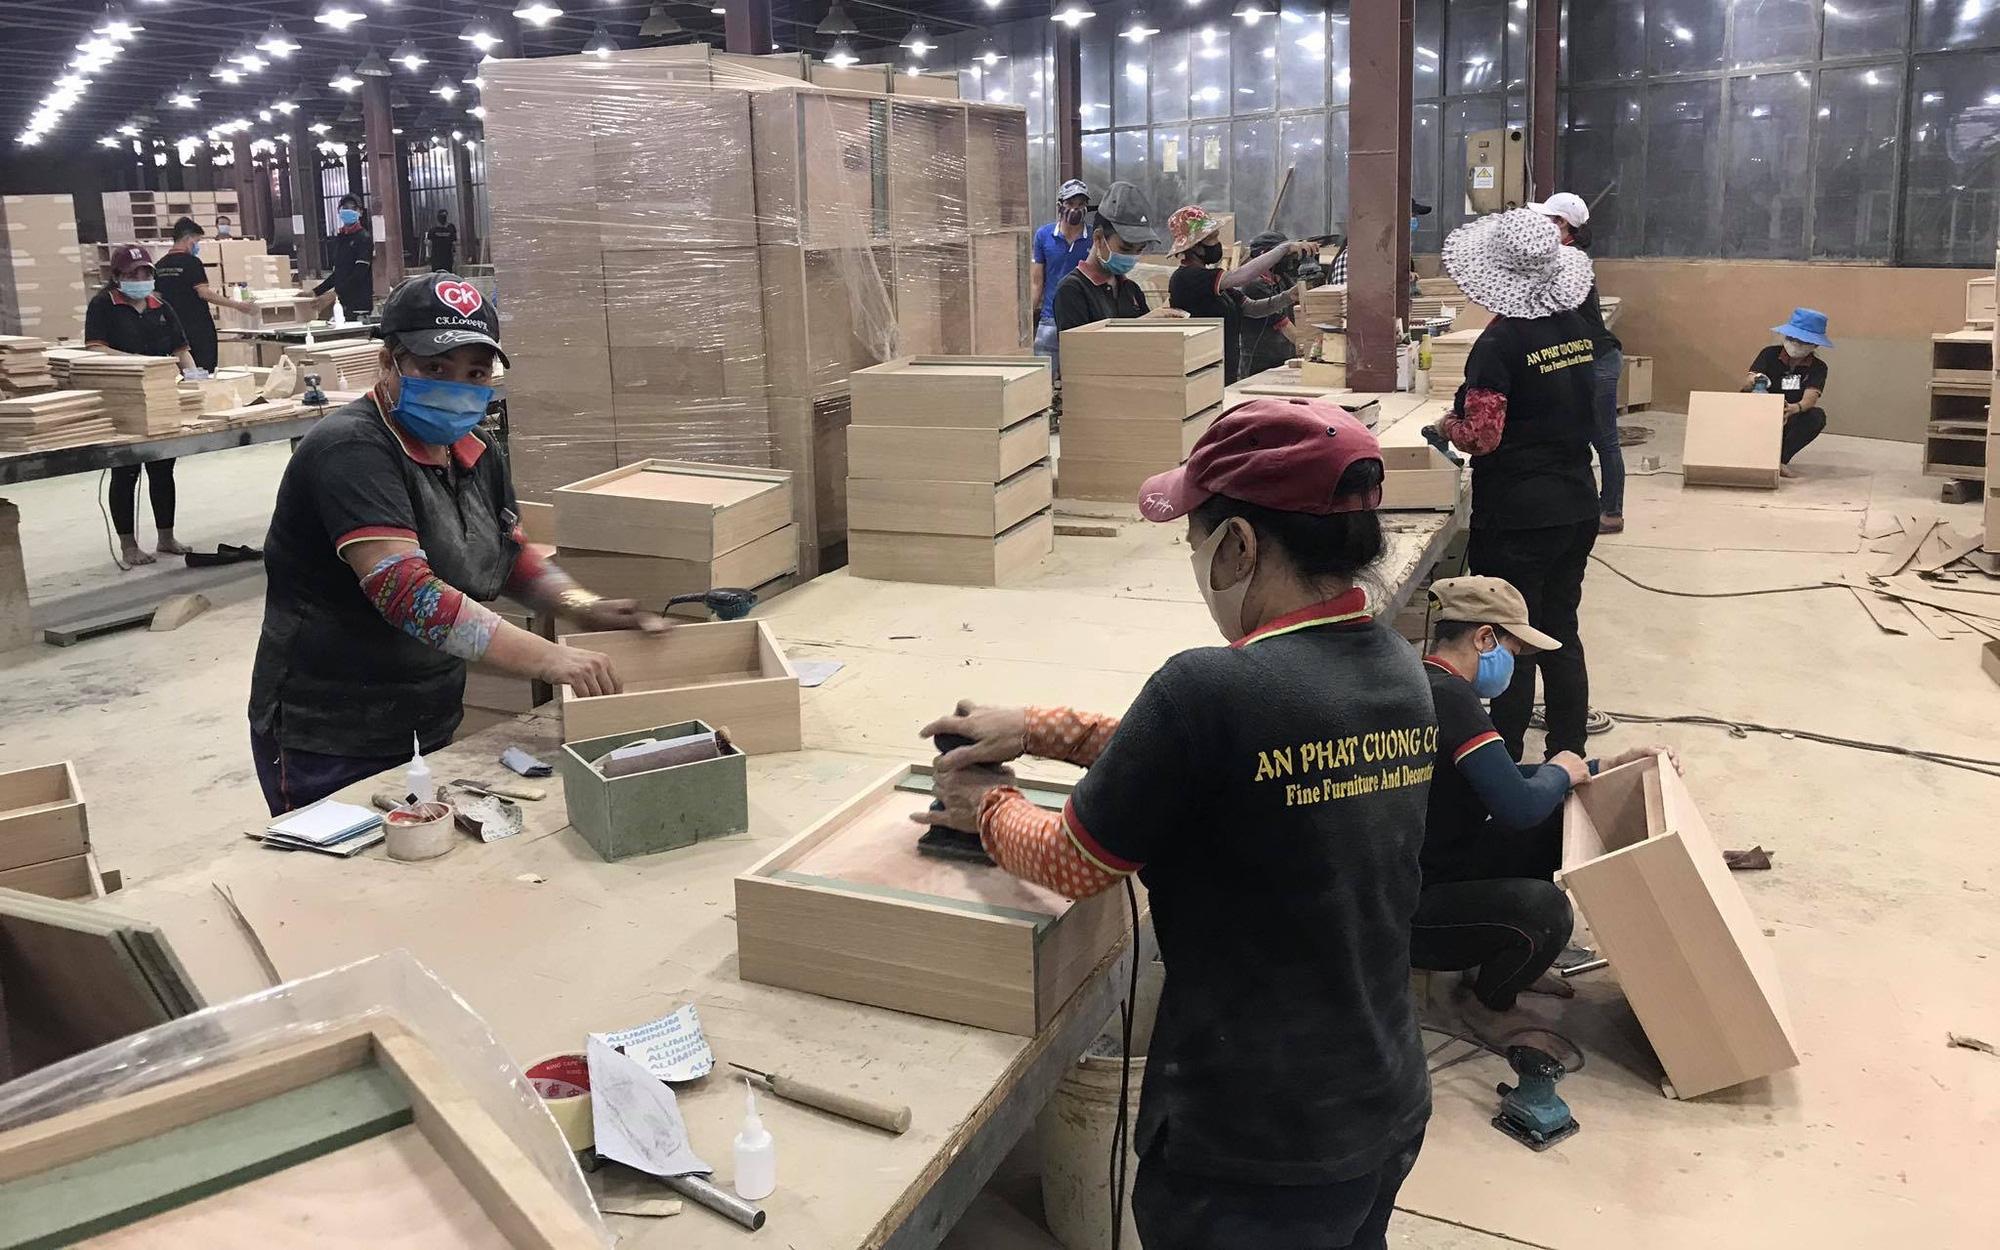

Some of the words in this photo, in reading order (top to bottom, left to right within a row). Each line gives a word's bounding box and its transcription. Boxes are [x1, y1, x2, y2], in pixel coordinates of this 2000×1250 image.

[444, 286, 478, 307] CK
[1526, 351, 1541, 366] AN
[1254, 746, 1293, 782] AN
[1299, 735, 1359, 773] PHAT
[1363, 727, 1420, 762] CUONG
[1286, 783, 1321, 806] Fine
[1323, 774, 1379, 801] Furniture
[1381, 766, 1400, 790] And
[607, 1015, 680, 1043] ALUMINUM
